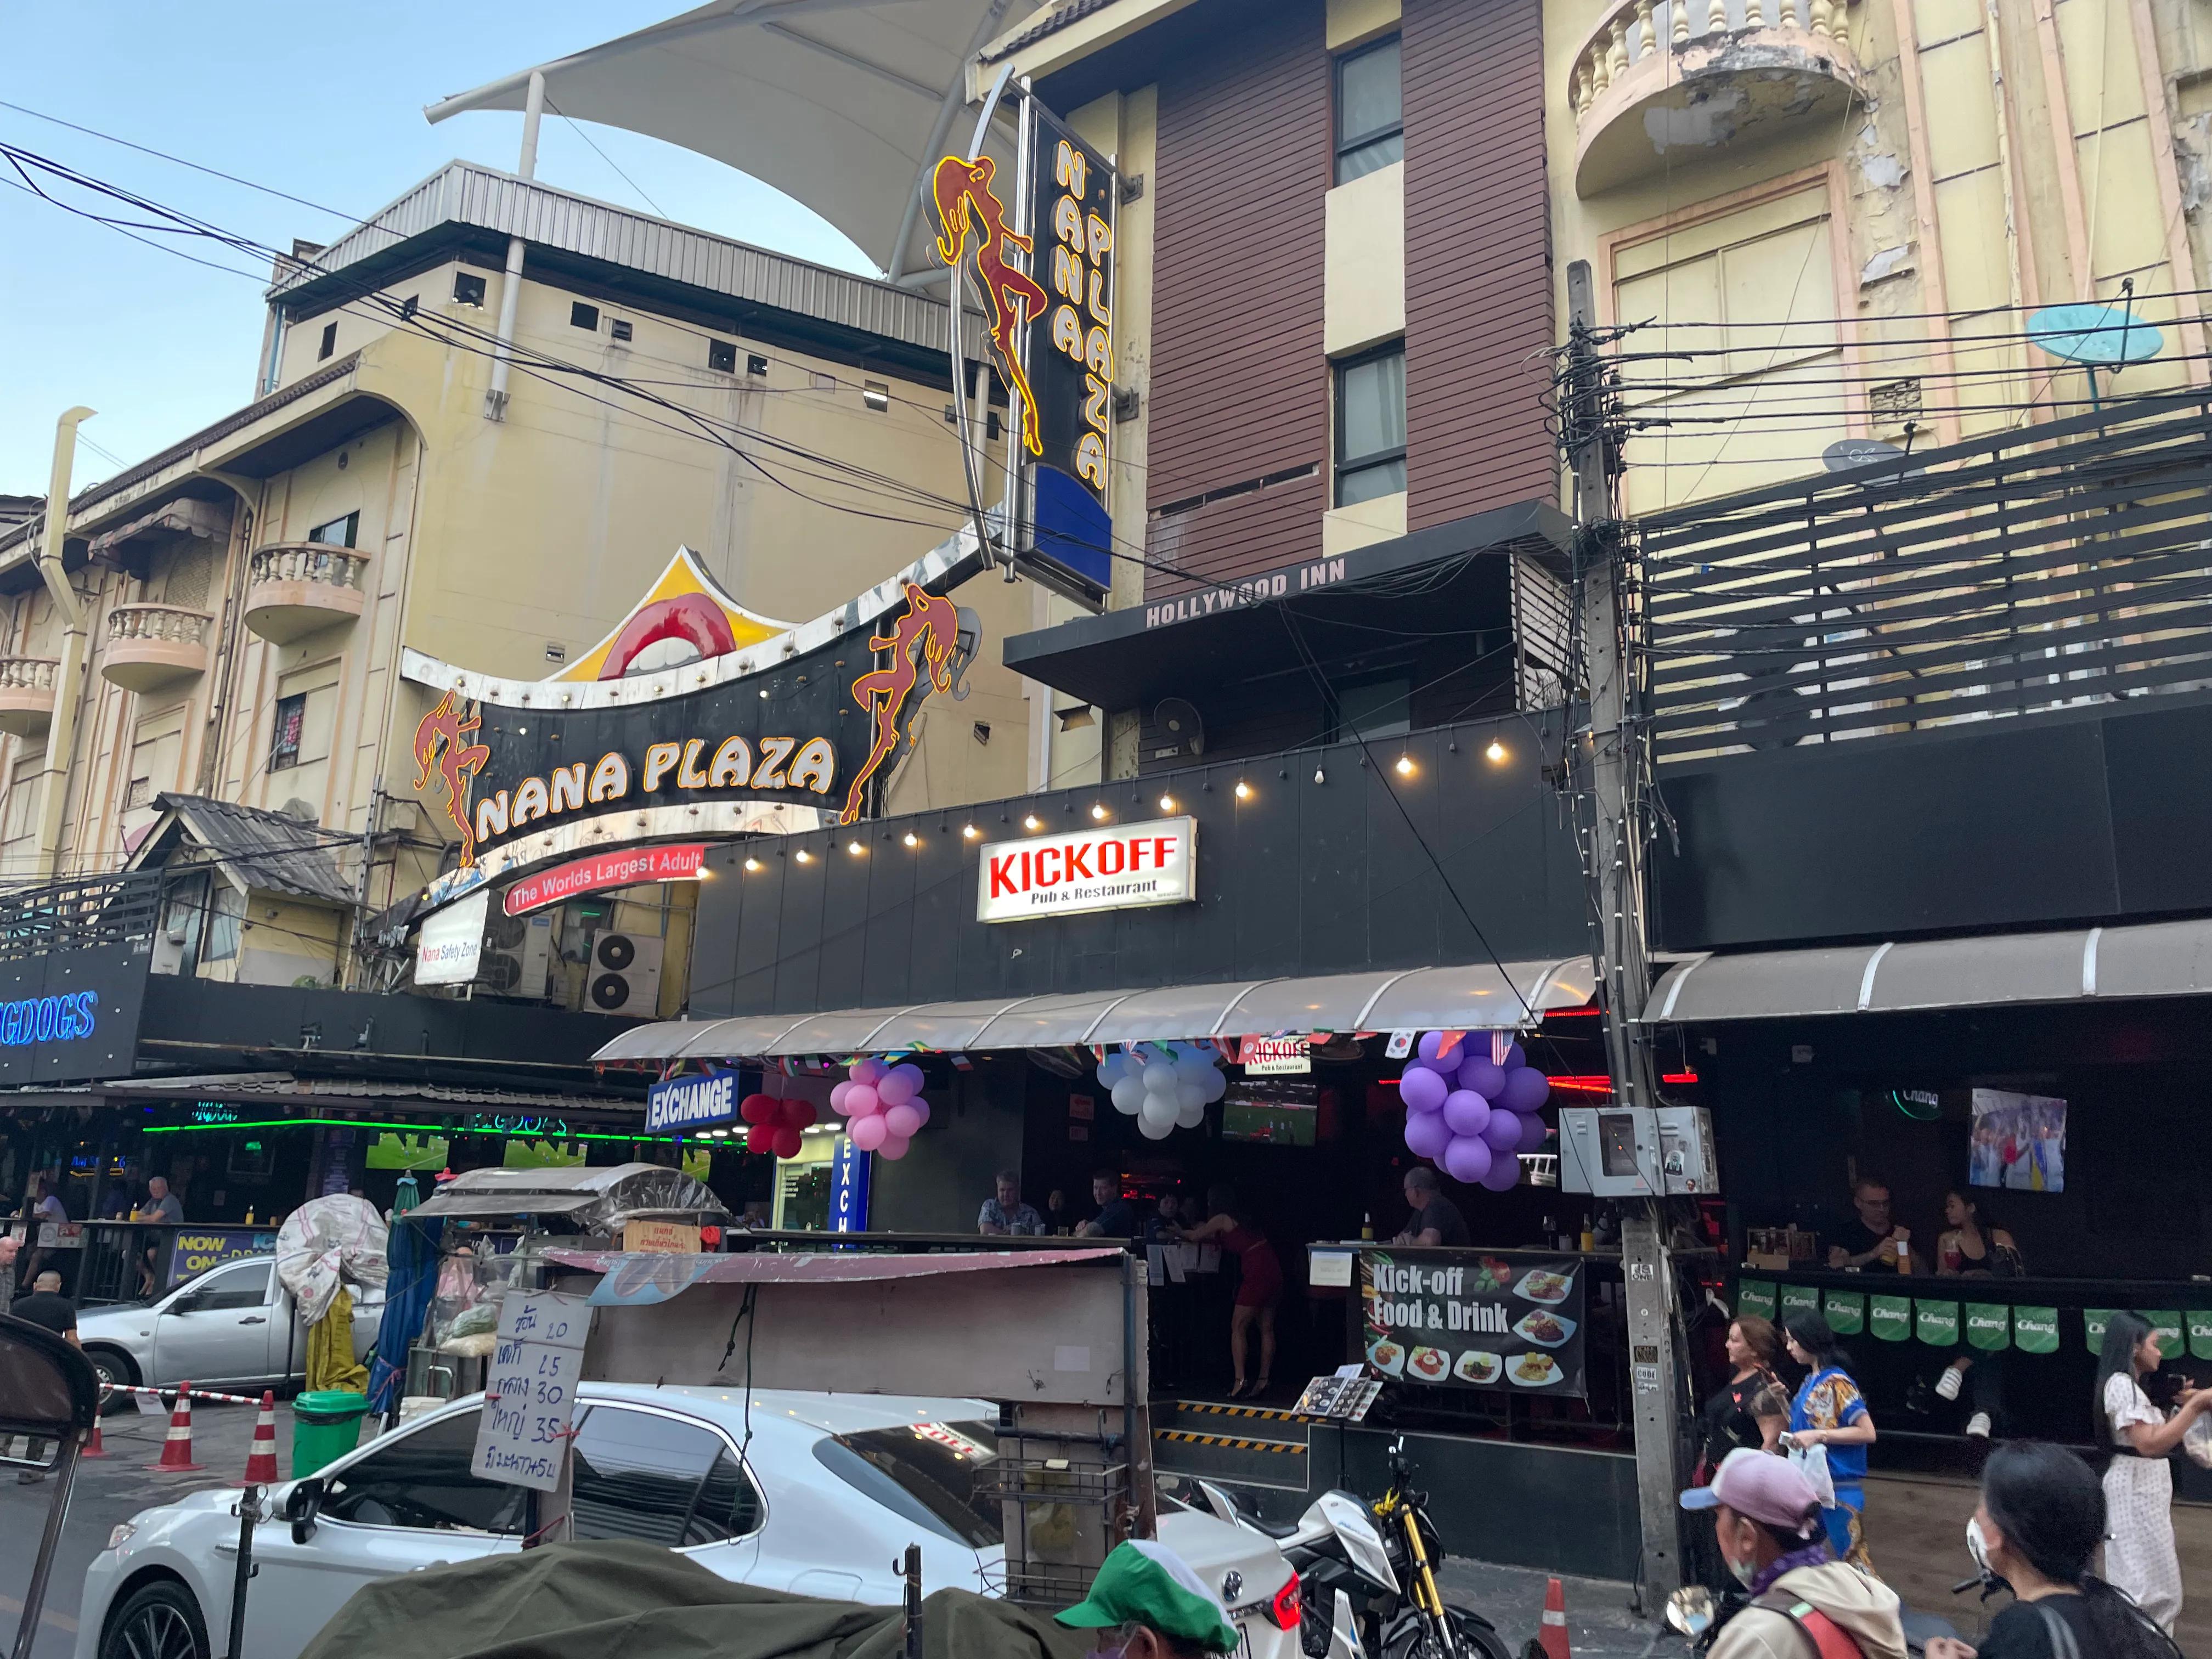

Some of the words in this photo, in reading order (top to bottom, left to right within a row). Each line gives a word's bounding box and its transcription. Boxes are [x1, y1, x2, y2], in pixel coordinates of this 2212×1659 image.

[1053, 140, 1086, 363] NANA
[1075, 212, 1114, 491] PLAZA
[1146, 574, 1287, 628] HOLLYWOOD
[1300, 558, 1345, 589] INN
[476, 752, 630, 843] NANA
[643, 736, 836, 794] PLAZA
[513, 886, 537, 907] The
[542, 868, 591, 899] Worlds
[597, 853, 655, 880] Largest
[659, 851, 701, 871] Adult
[990, 837, 1177, 899] KICKOFF
[1031, 891, 1057, 905] Pub
[1060, 891, 1070, 901] &
[1074, 879, 1158, 900] Restaurant
[422, 946, 440, 962] Nana
[441, 943, 461, 962] Safety
[461, 942, 477, 958] Zone
[0, 991, 99, 1046] GDOGS
[651, 1076, 733, 1130] EXCHANGE
[178, 1236, 226, 1251] NOW
[186, 1255, 217, 1270] ON
[1373, 1263, 1464, 1296] Kick-off
[1741, 1290, 1774, 1306] Chang
[1783, 1295, 1816, 1309] Chang
[1827, 1301, 1861, 1317] Chang
[1373, 1296, 1423, 1328] Food
[1427, 1306, 1443, 1330] &
[1448, 1301, 1509, 1334] Drink
[1872, 1307, 1908, 1322] Chang
[1920, 1312, 1956, 1327] Chang
[1969, 1316, 2006, 1331] Chang
[2017, 1319, 2055, 1334] Chang
[537, 1381, 563, 1404] 30
[531, 1417, 560, 1443] 35
